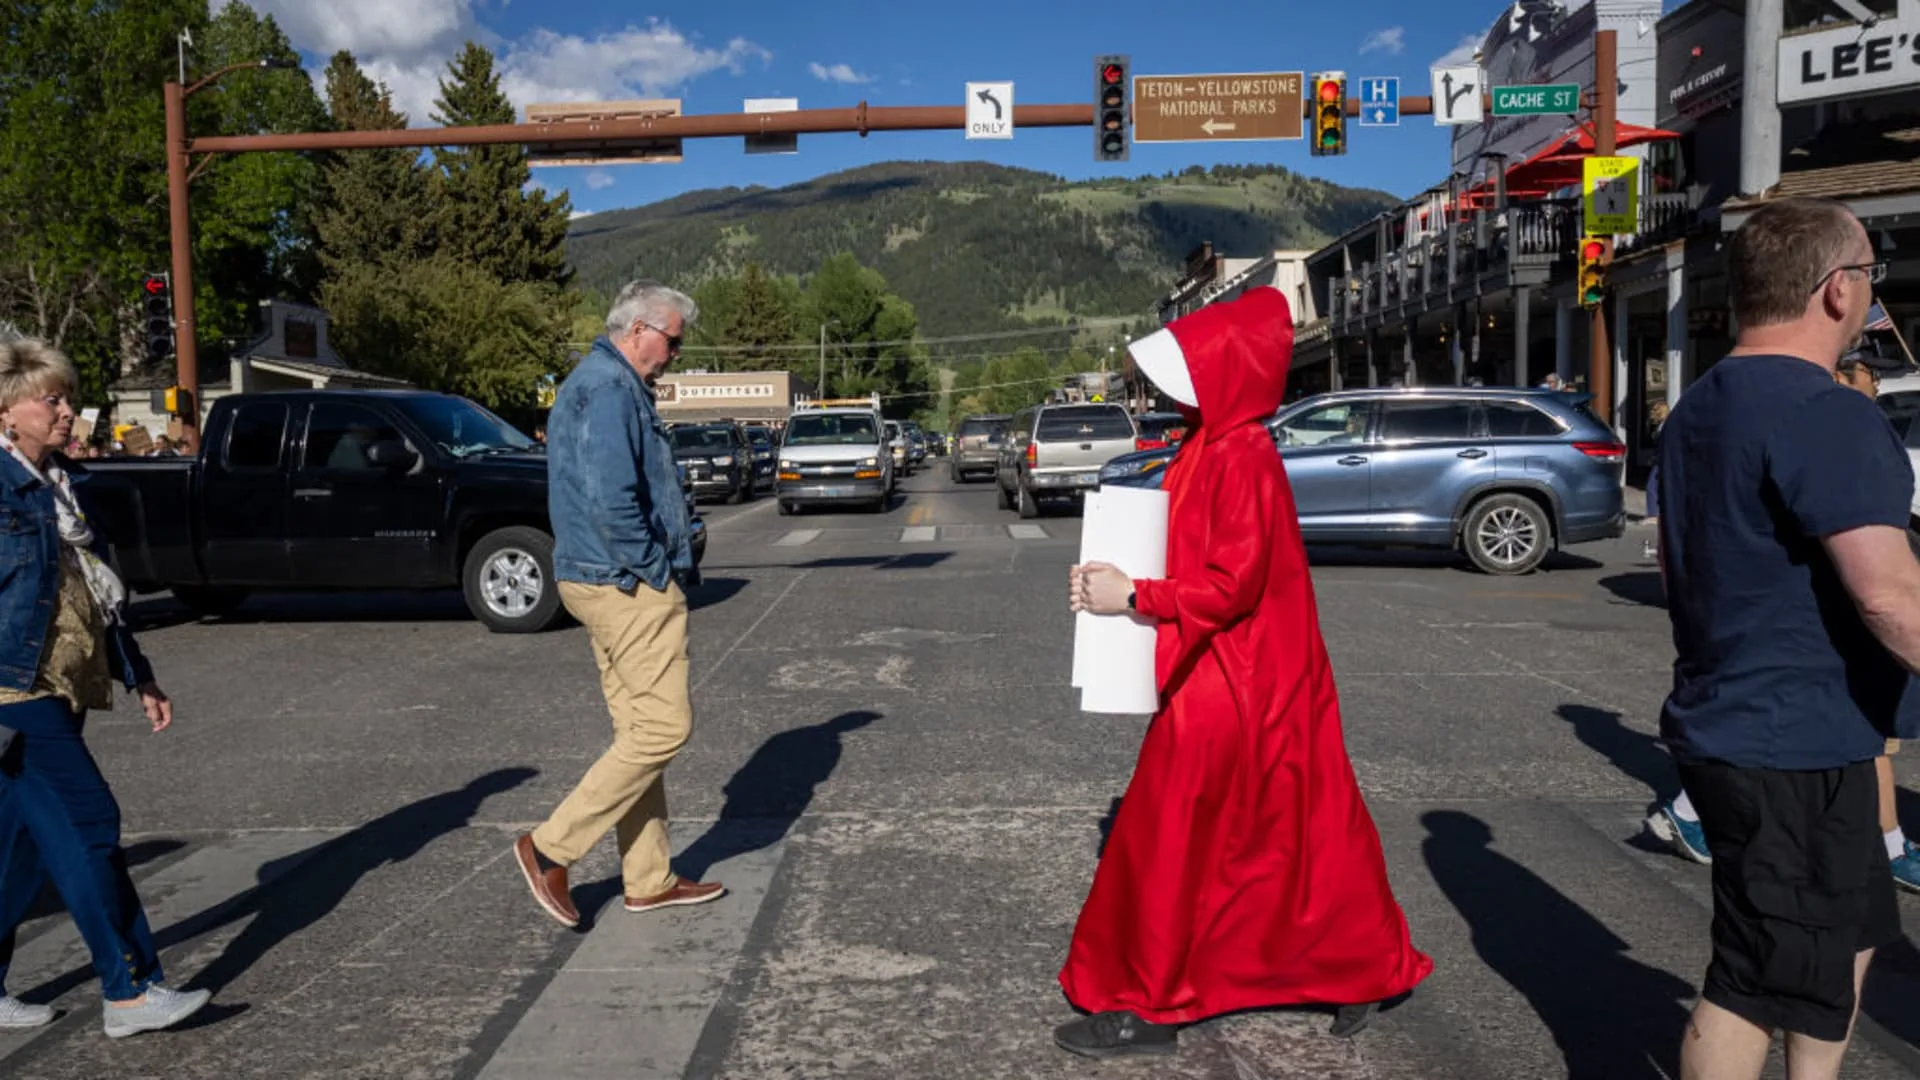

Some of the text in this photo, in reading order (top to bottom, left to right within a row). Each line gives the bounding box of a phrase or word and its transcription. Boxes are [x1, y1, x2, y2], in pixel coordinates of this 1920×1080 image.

[1372, 79, 1387, 102] H
[1160, 98, 1276, 117] NATIONAL PARKS
[1500, 91, 1571, 108] CACHE ST
[972, 123, 1006, 133] ONLY
[680, 387, 769, 397] OUTFITTERS
